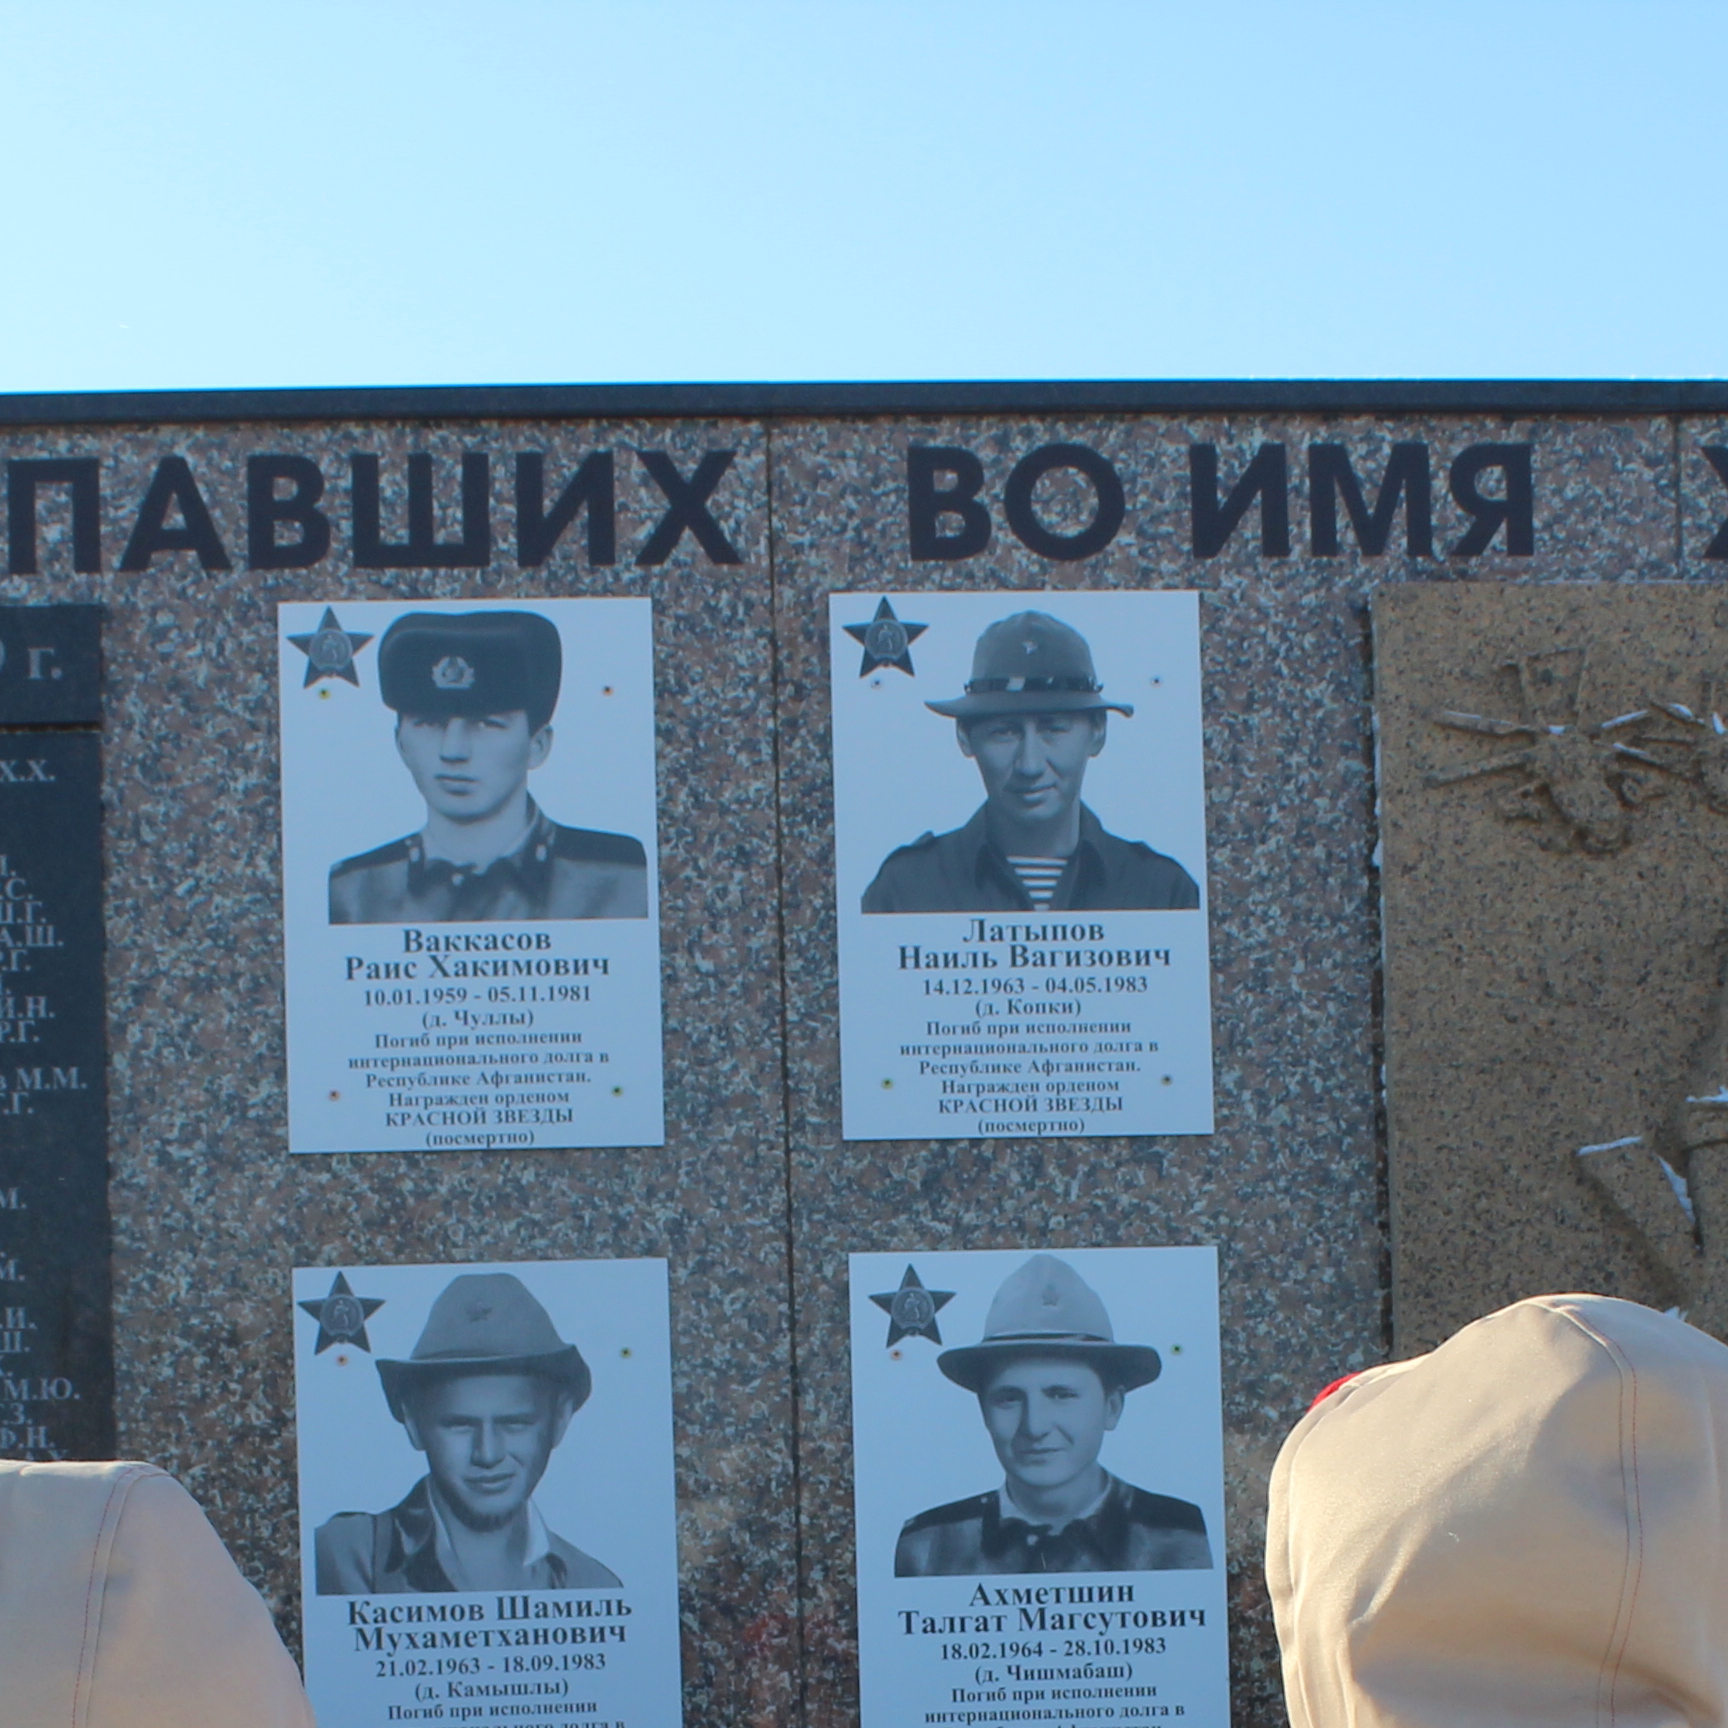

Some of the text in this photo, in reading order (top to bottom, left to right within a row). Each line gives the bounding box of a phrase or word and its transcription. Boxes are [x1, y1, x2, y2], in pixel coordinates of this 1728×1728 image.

[4, 449, 746, 577] ПАВШИХ
[909, 446, 1127, 565] ВО
[1188, 443, 1534, 562] ИМЯ
[27, 645, 64, 681] г.
[403, 928, 552, 954] Ваккасов
[962, 918, 1105, 943] Латыпов
[345, 954, 610, 981] Раис Хакимович
[898, 944, 1171, 970] Наиль Вагизович
[364, 987, 467, 1006] 10.01.1959
[487, 985, 591, 1003] 05.11.1981
[922, 977, 1025, 996] 14.12.1963
[1045, 976, 1148, 994] 04.05.1983
[975, 998, 1082, 1018] (д. Копки)
[422, 1008, 534, 1030] (д. Чуллы)
[926, 1020, 1132, 1039] Погиб при исполнении
[374, 1032, 582, 1051] Погиб при исполнении
[900, 1040, 1159, 1059] интернационального долга в
[348, 1052, 609, 1071] интернационального долга в
[919, 1058, 1141, 1079] Республике Афганистан.
[366, 1070, 591, 1092] Республике Афганистан.
[941, 1079, 1120, 1097] Награжден орденом
[388, 1091, 570, 1111] Награжден орденом
[938, 1095, 1123, 1115] КРАСНОЙ ЗВЕЗДЫ
[385, 1107, 573, 1128] КРАСНОЙ ЗВЕЗДЫ
[978, 1117, 1085, 1136] (посмертно)
[426, 1130, 535, 1148] (посмертно)
[969, 1582, 1134, 1607] Ахметшин
[348, 1595, 632, 1627] Касимов Шамиль
[898, 1607, 1206, 1637] Талгат Магсутович
[354, 1625, 627, 1657] Мухаметханович
[940, 1640, 1043, 1661] 18.02.1964
[1063, 1638, 1167, 1657] 28.10.1983
[376, 1657, 481, 1679] 21.02.1963
[502, 1653, 606, 1674] 18.09.1983
[975, 1662, 1133, 1684] (д. Чишмабаш)
[415, 1678, 569, 1702] (д. Камышлы)
[951, 1685, 1157, 1705] Погиб при исполнении
[388, 1701, 597, 1721] Погиб при исполнении
[924, 1704, 1185, 1725] интернационального долга в
